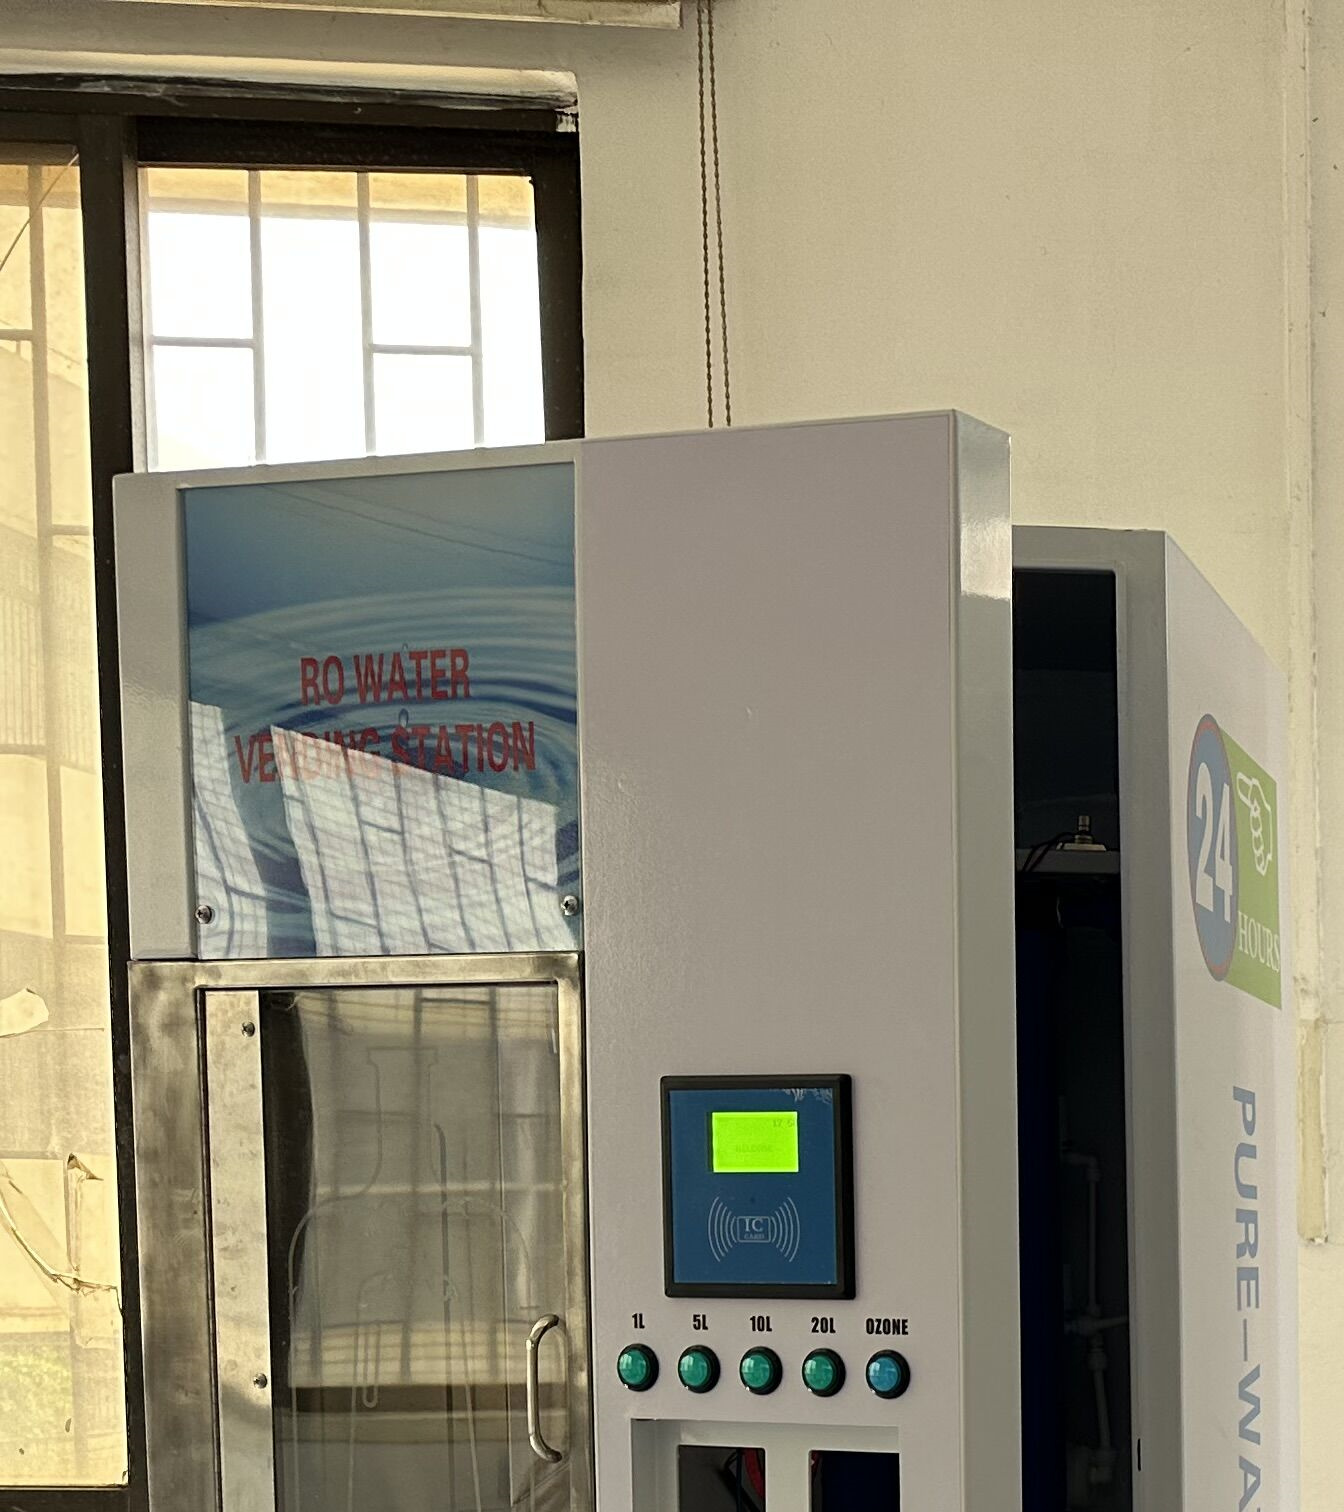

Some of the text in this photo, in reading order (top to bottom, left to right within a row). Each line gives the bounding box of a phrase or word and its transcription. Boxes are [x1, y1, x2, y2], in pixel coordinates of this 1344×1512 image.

[301, 648, 470, 706] RO WATER
[236, 721, 536, 784] VENDING STATION
[1196, 762, 1233, 923] 24
[1238, 910, 1280, 973] HOURS
[745, 1218, 764, 1232] IC
[632, 1313, 645, 1329] 1L
[692, 1314, 708, 1331] 5L
[750, 1316, 772, 1332] 10L
[811, 1317, 836, 1334] 20L
[866, 1318, 908, 1335] OZONE
